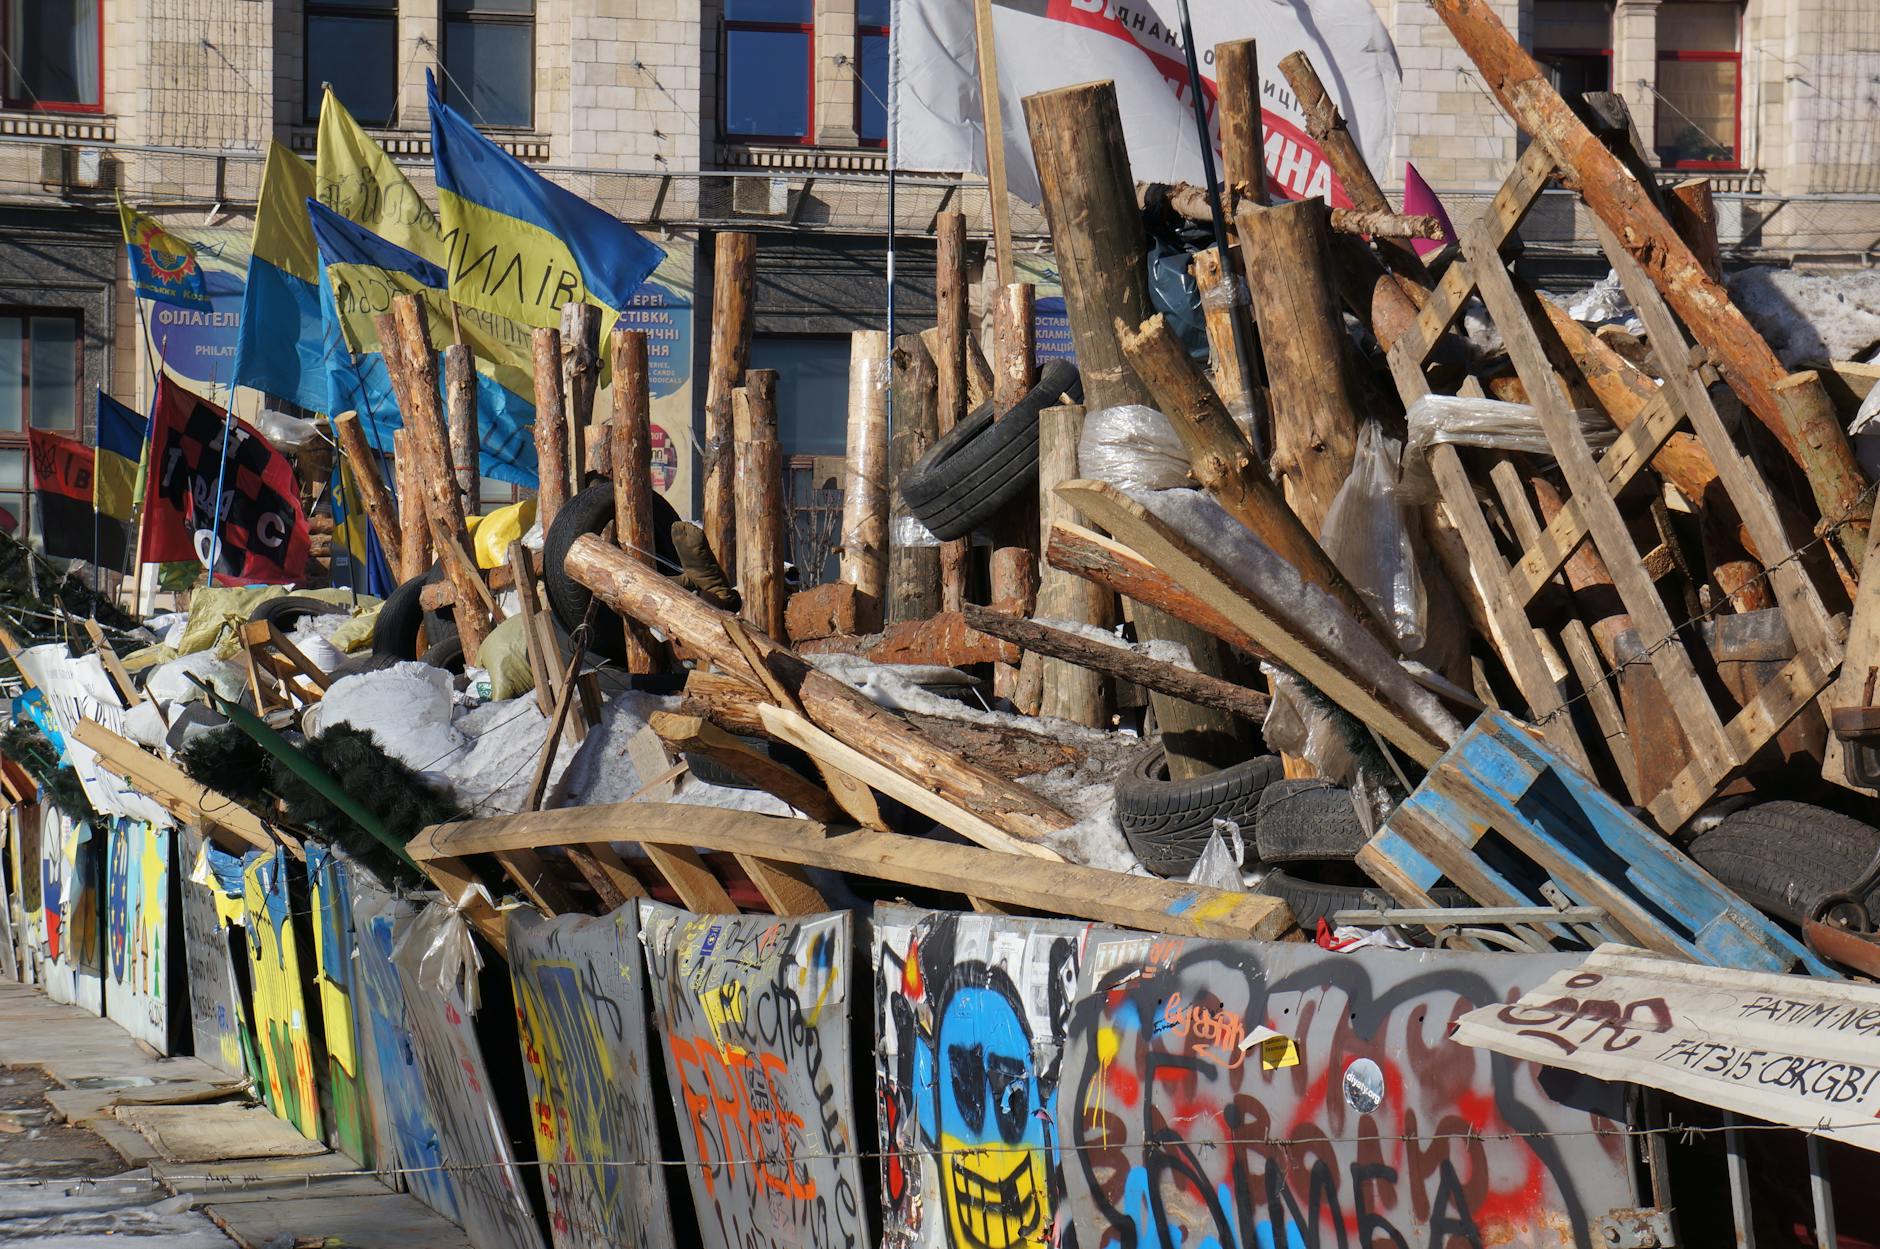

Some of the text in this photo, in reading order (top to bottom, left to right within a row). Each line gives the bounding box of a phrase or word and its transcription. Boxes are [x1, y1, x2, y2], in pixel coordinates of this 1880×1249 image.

[443, 227, 587, 312] ИЛІВ
[628, 294, 667, 306] ЕРЕЇ,
[1345, 1071, 1381, 1105] diyaty.org
